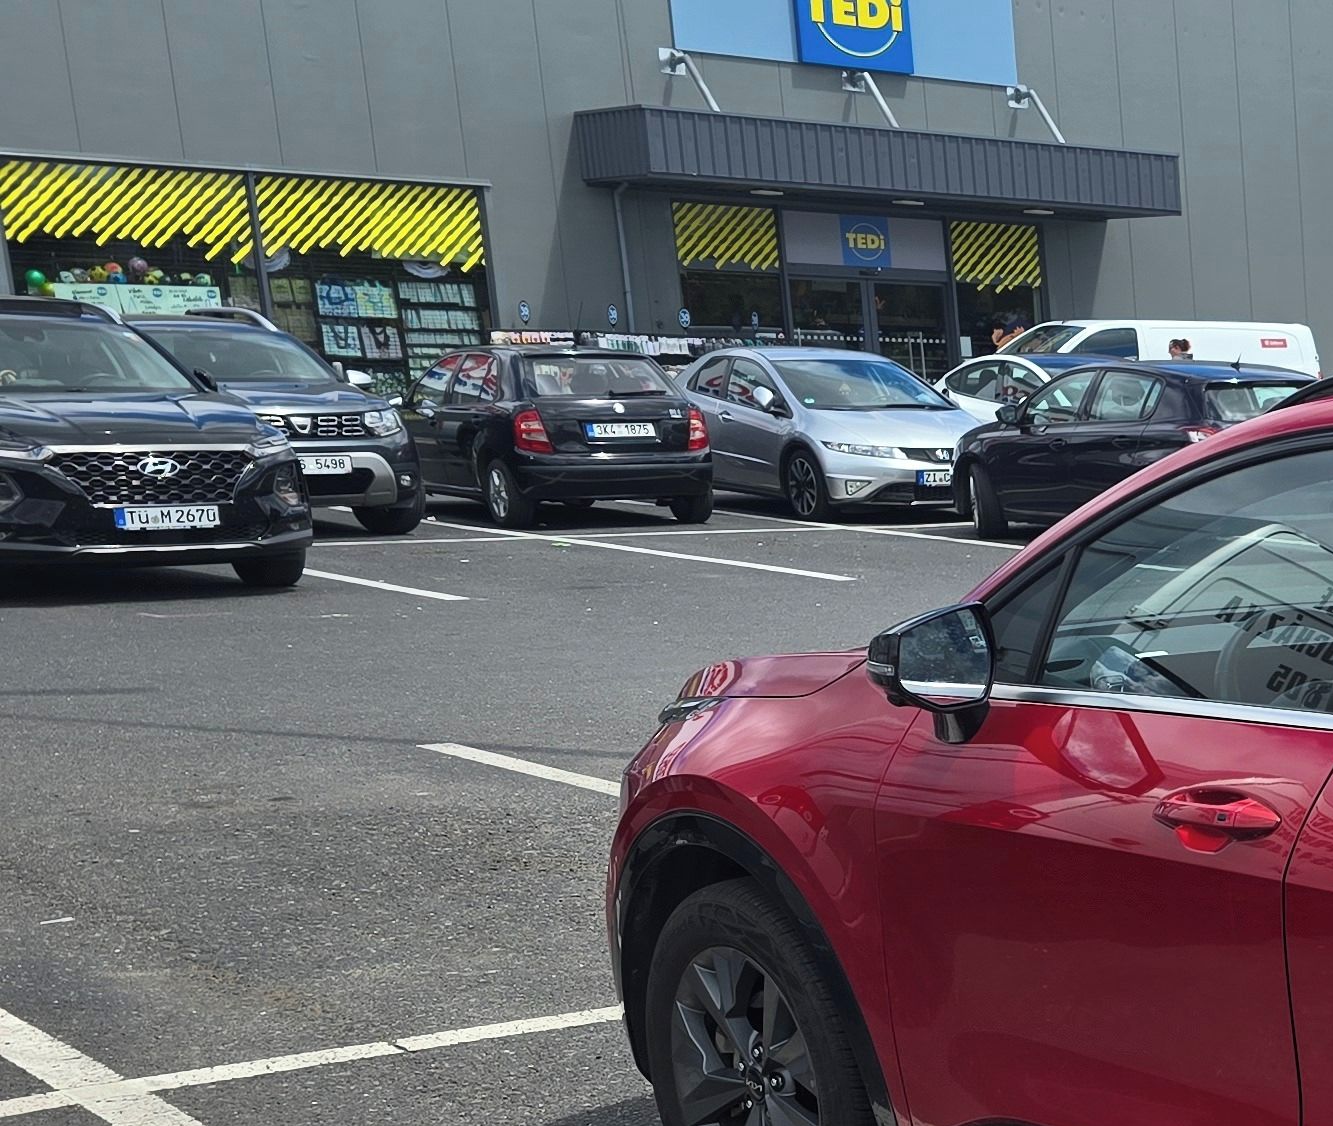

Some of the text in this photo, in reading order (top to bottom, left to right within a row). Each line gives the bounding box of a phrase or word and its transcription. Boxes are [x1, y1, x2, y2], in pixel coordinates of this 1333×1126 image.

[809, 0, 904, 32] TEDi
[846, 232, 885, 250] TEDi
[624, 424, 650, 435] 1875
[315, 458, 346, 470] 5498
